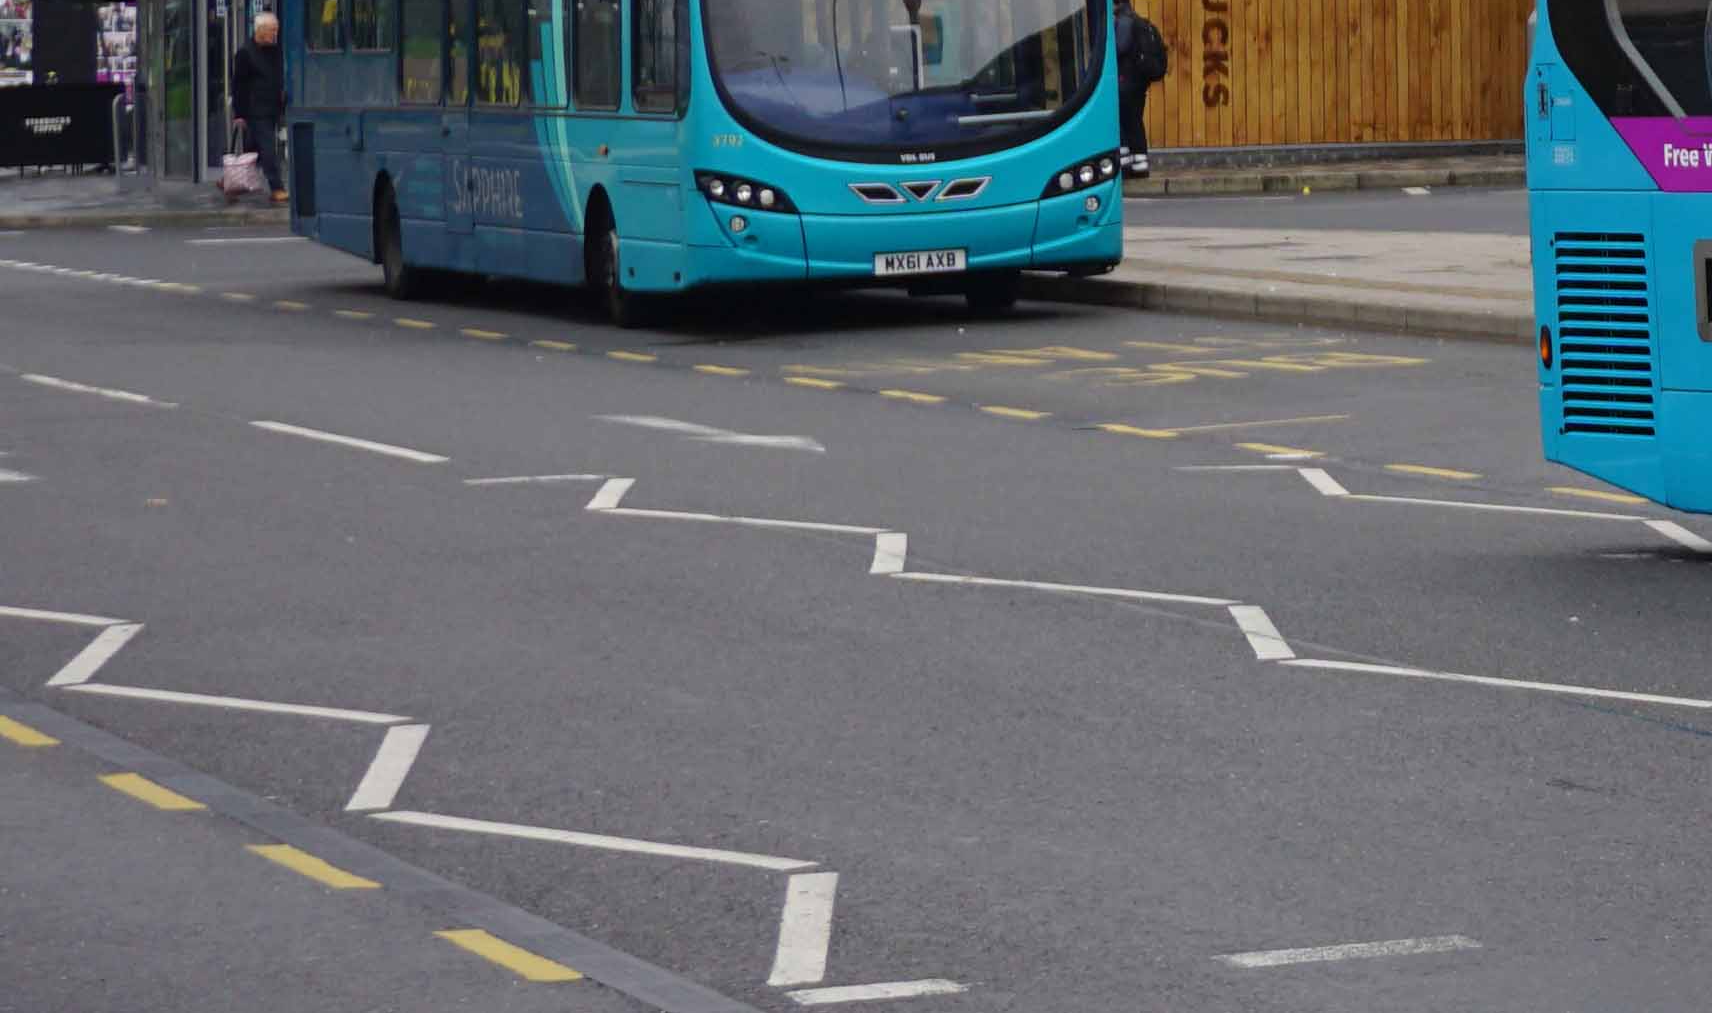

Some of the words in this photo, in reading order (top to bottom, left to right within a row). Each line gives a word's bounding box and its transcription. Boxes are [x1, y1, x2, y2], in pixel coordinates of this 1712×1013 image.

[1663, 143, 1699, 167] Free
[885, 253, 921, 272] MX61
[926, 251, 956, 269] AXB
